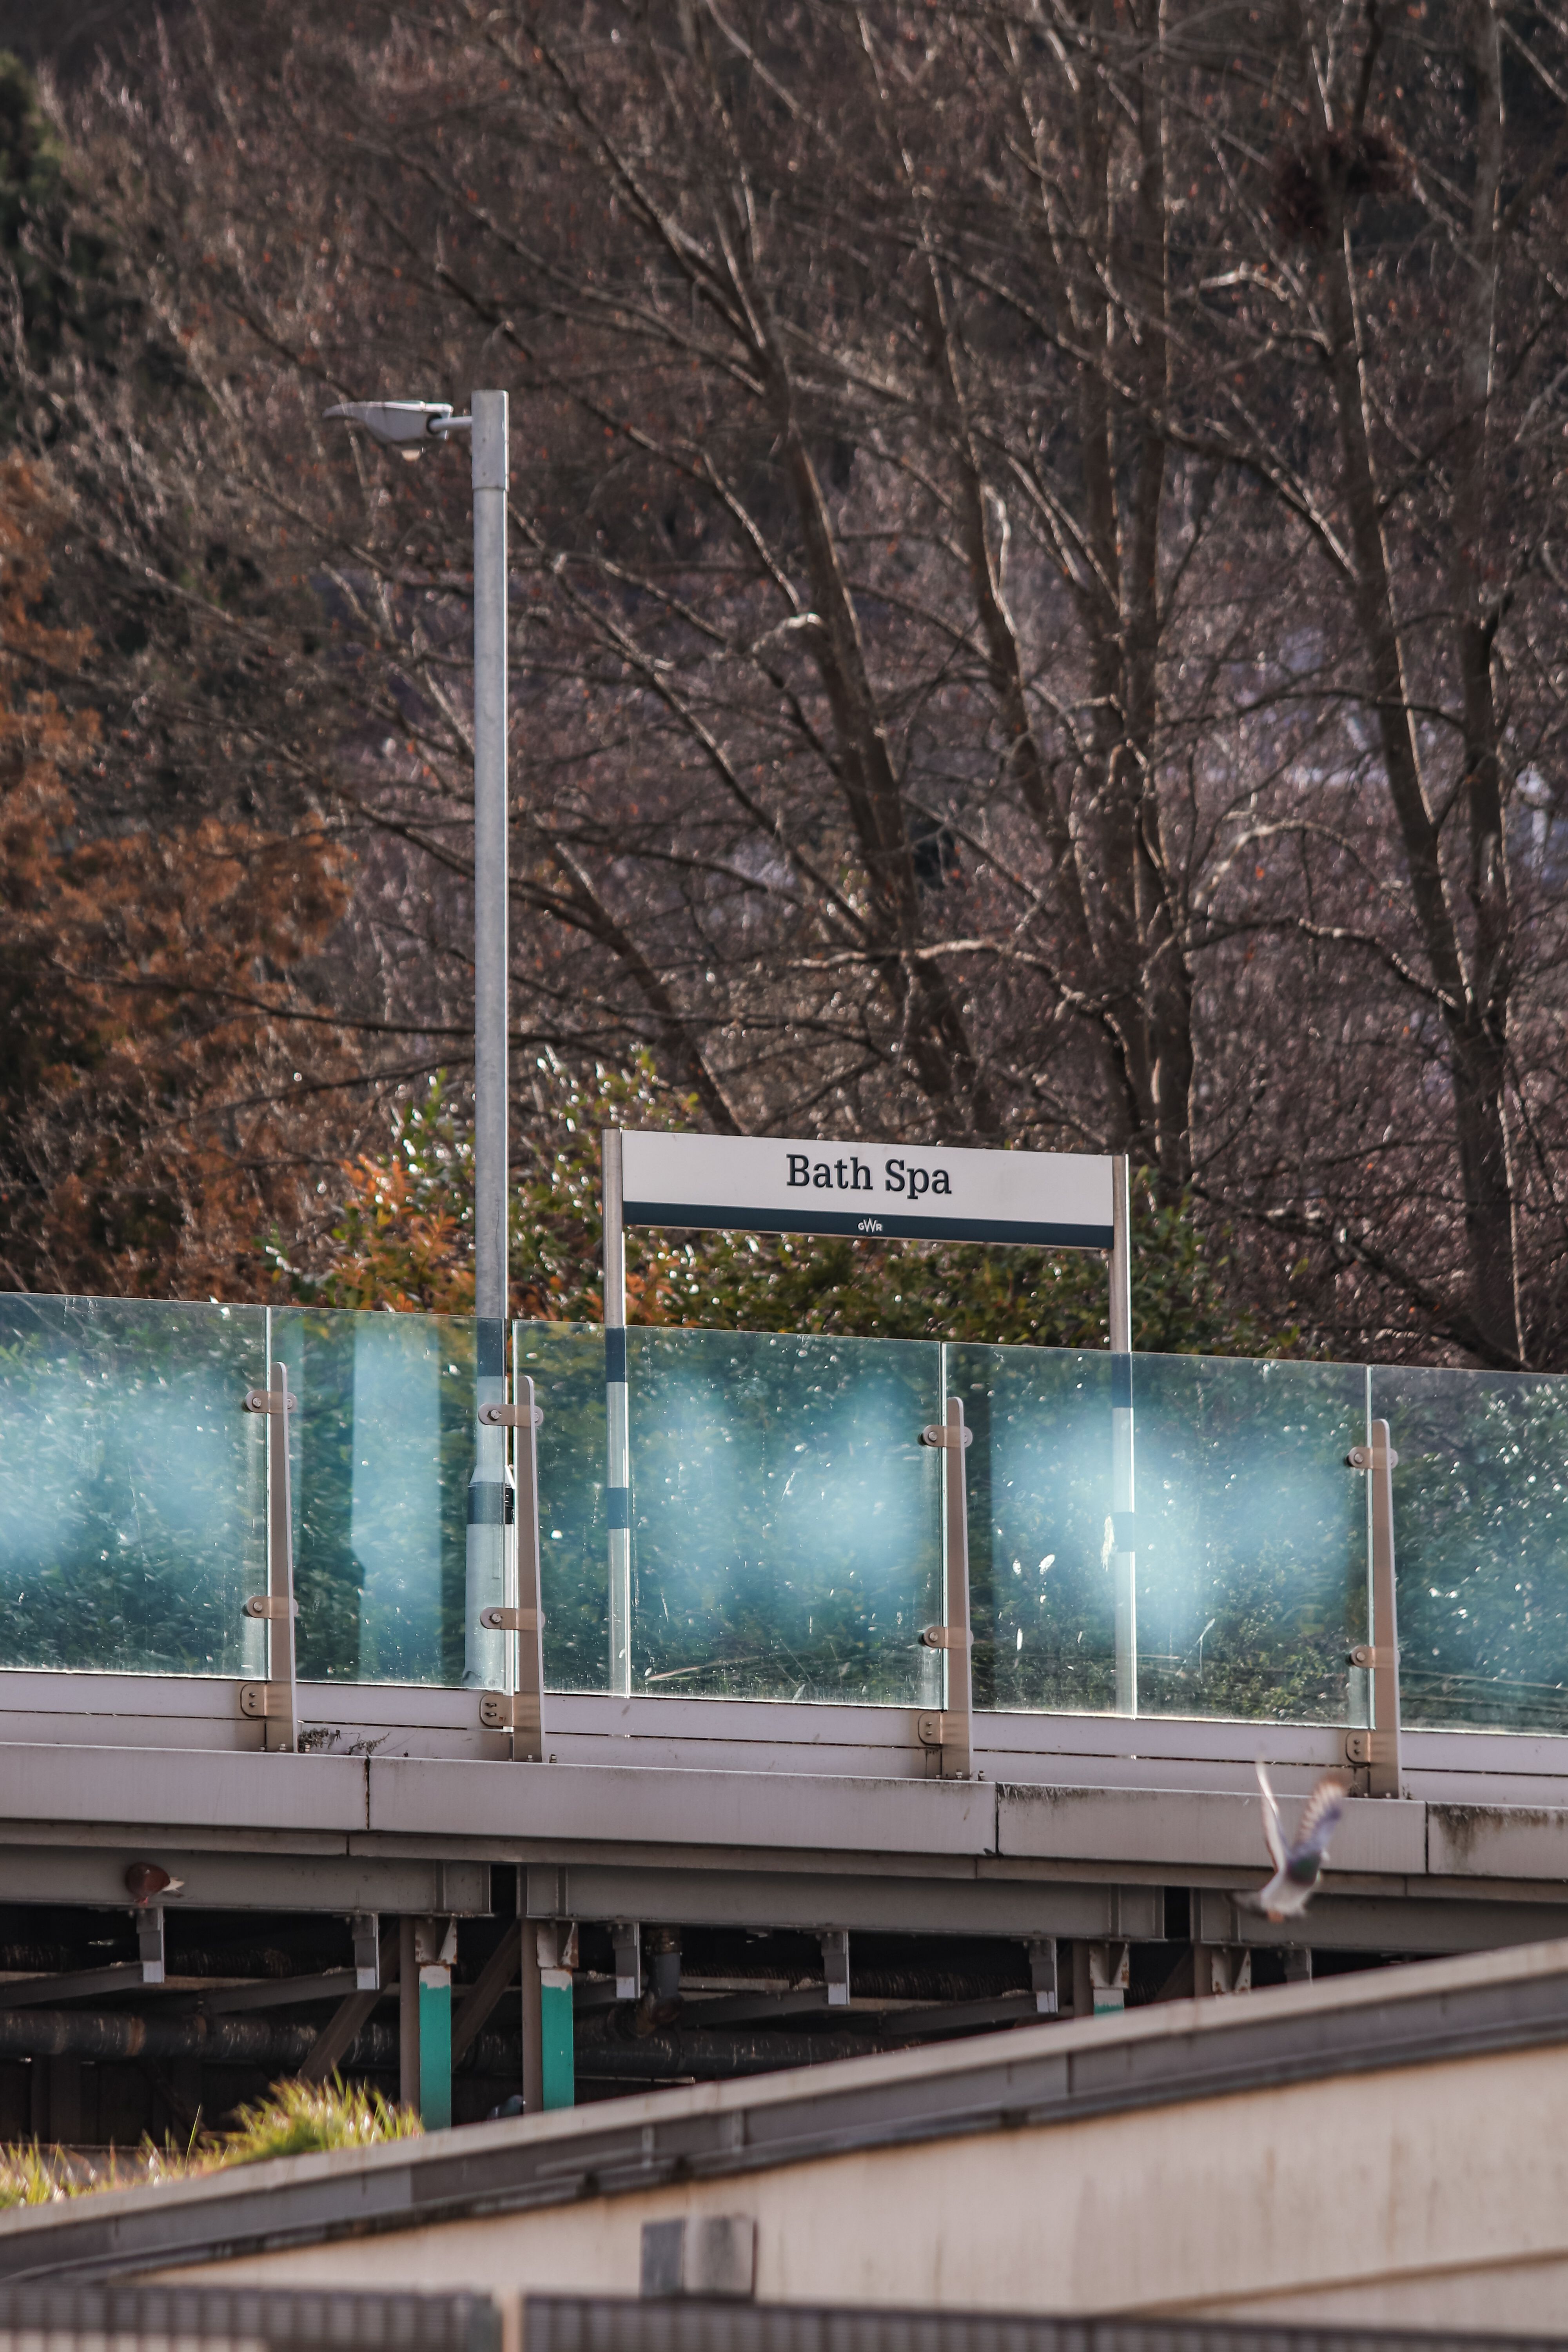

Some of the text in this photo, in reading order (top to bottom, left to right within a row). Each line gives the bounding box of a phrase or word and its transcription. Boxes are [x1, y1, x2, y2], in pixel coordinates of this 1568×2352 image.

[786, 1154, 952, 1200] Bath Spa
[858, 1218, 882, 1233] GWR
